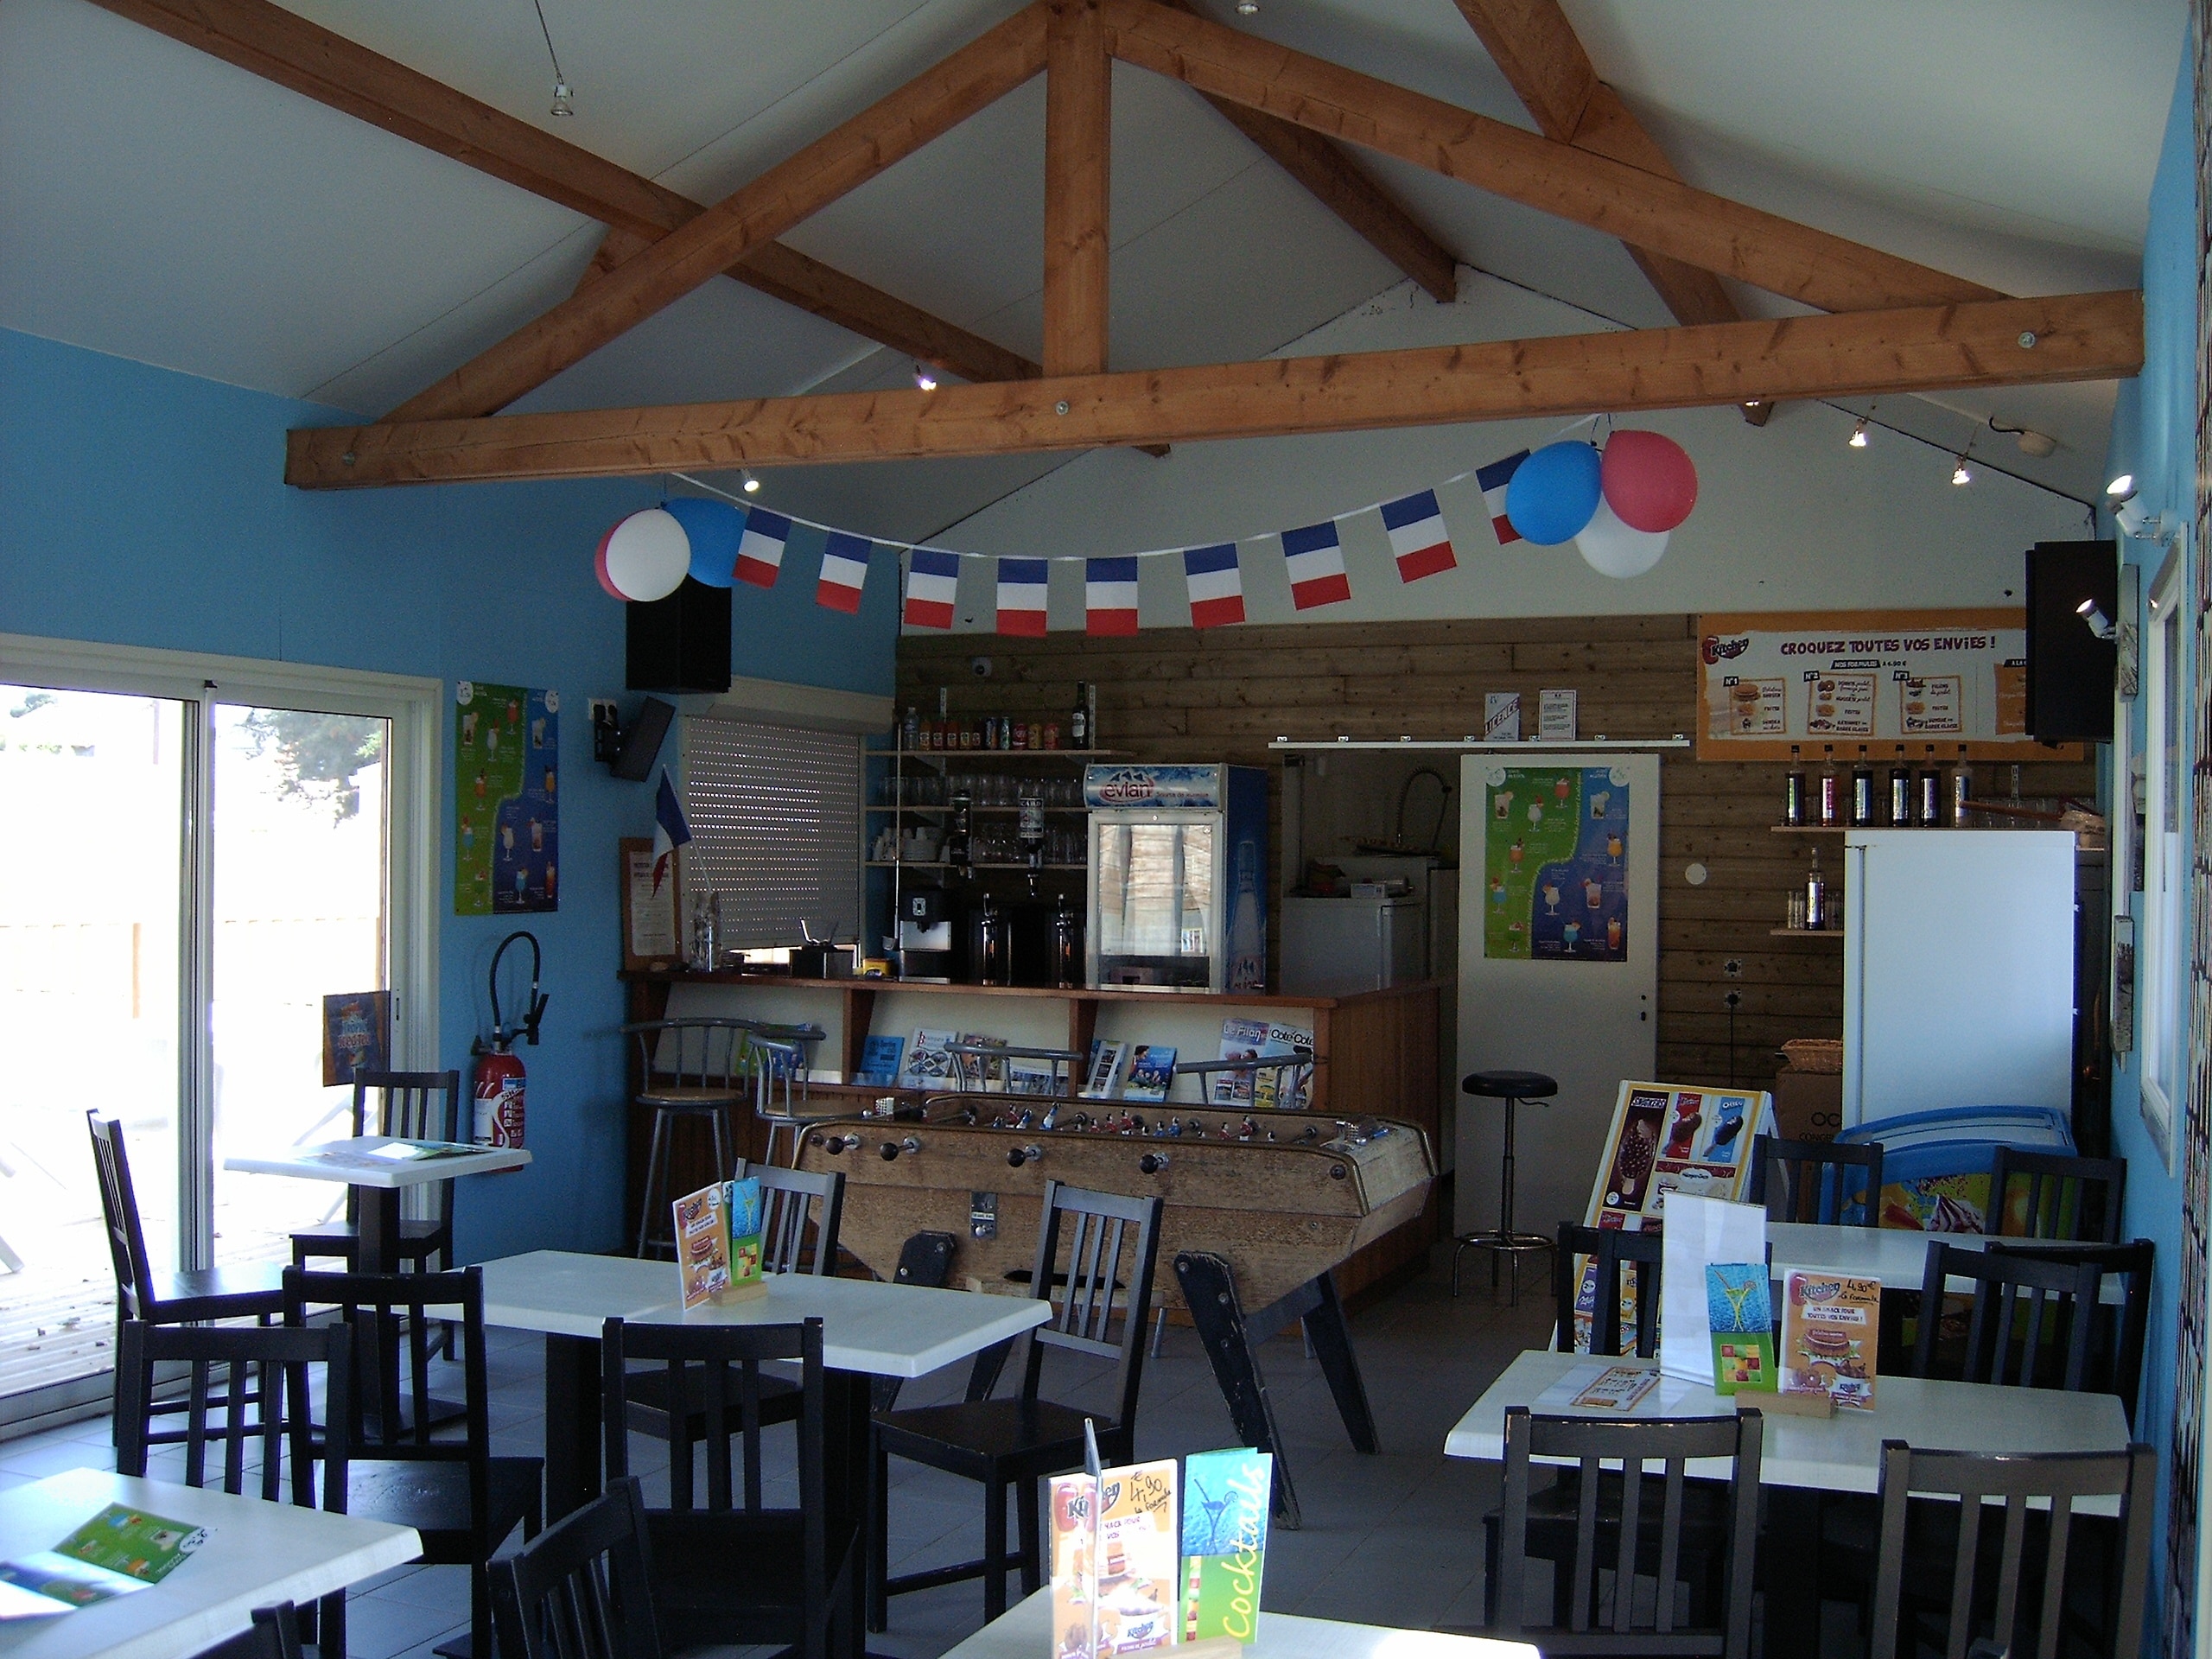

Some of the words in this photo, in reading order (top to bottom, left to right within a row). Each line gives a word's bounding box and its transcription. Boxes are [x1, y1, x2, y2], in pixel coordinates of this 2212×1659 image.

[1780, 641, 1845, 655] CROQUEZ
[1849, 639, 1899, 652] TOUTES
[1904, 638, 1929, 652] VOS
[1104, 781, 1151, 798] evian
[1221, 1463, 1266, 1638] Cocktails
